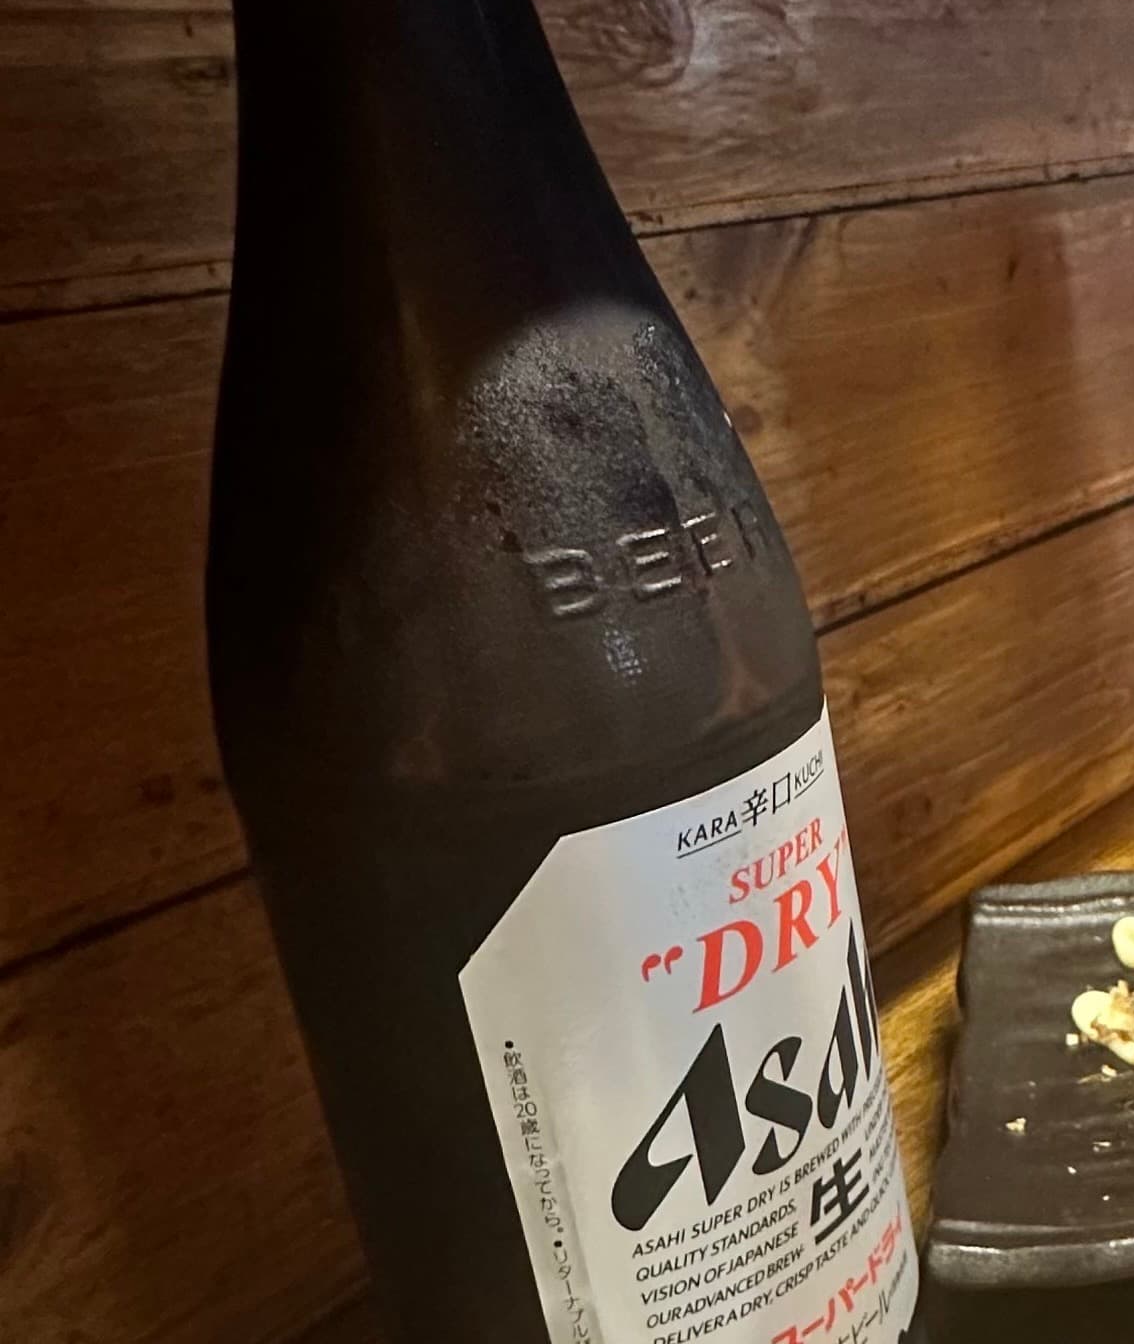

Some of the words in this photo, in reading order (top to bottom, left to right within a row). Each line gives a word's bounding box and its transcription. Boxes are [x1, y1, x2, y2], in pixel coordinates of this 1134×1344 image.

[677, 809, 738, 852] KARA
[741, 771, 791, 828] 辛口
[728, 817, 823, 905] SUPER
[631, 1228, 686, 1259] ASAHI
[690, 1204, 743, 1240] SUPER
[746, 1184, 777, 1214] DRY
[779, 1175, 791, 1195] IS
[794, 1137, 841, 1185] BREWED
[810, 1147, 870, 1246] 生
[635, 1244, 709, 1283] QUALITY
[640, 1273, 701, 1305] VISION
[703, 1261, 729, 1284] OF
[725, 1221, 800, 1275] JAPANESE
[646, 1306, 682, 1330] OUR
[682, 1269, 766, 1315] ADVANCED
[725, 1308, 738, 1327] A
[775, 1261, 814, 1298] CRISP
[815, 1234, 849, 1272] TASTE
[850, 1209, 872, 1237] AND
